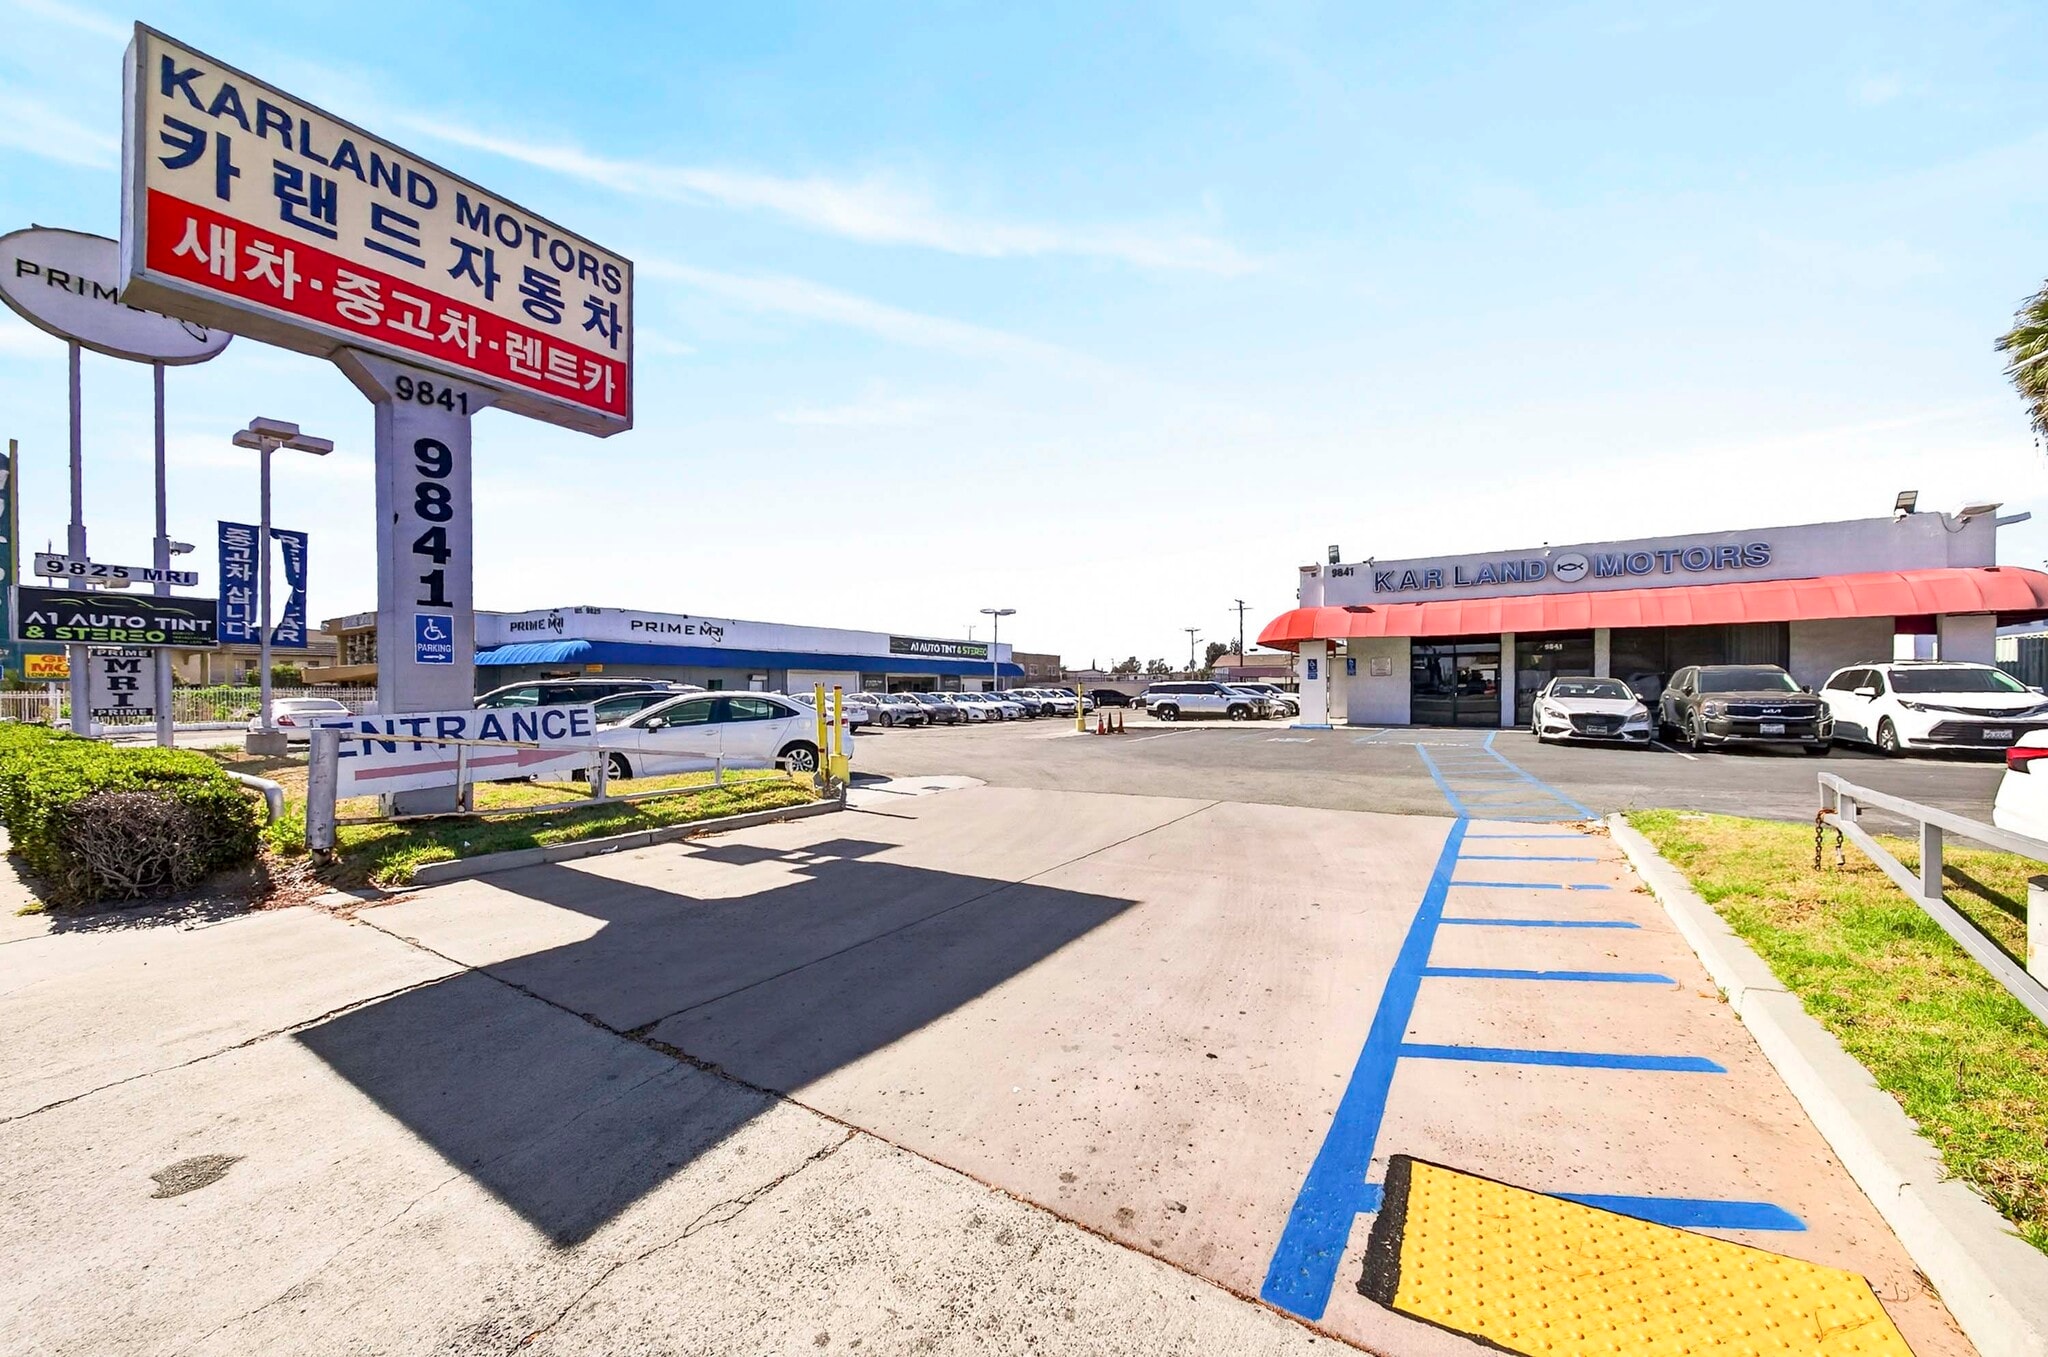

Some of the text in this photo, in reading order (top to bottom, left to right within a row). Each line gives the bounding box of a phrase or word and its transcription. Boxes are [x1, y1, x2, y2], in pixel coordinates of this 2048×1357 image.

[161, 54, 622, 295] KARLAND MOTORS
[16, 258, 146, 312] PRIM
[395, 375, 467, 415] 9841
[412, 437, 453, 608] 9841
[46, 560, 191, 583] 9825 MRI
[1332, 568, 1354, 578] 9841
[1372, 541, 1773, 593] KAR LAND MOTORS
[68, 613, 146, 628] AUTO
[154, 617, 212, 632] TINT
[510, 619, 545, 632] PRIME
[631, 620, 695, 635] PRIME
[25, 625, 45, 640] &
[56, 627, 166, 642] STEREO
[97, 649, 148, 657] PRIME
[417, 643, 452, 653] PARKING
[920, 643, 940, 653] AUTO
[104, 659, 141, 707] MRI
[98, 708, 148, 716] PRIME
[320, 709, 592, 758] ENTRANCE
